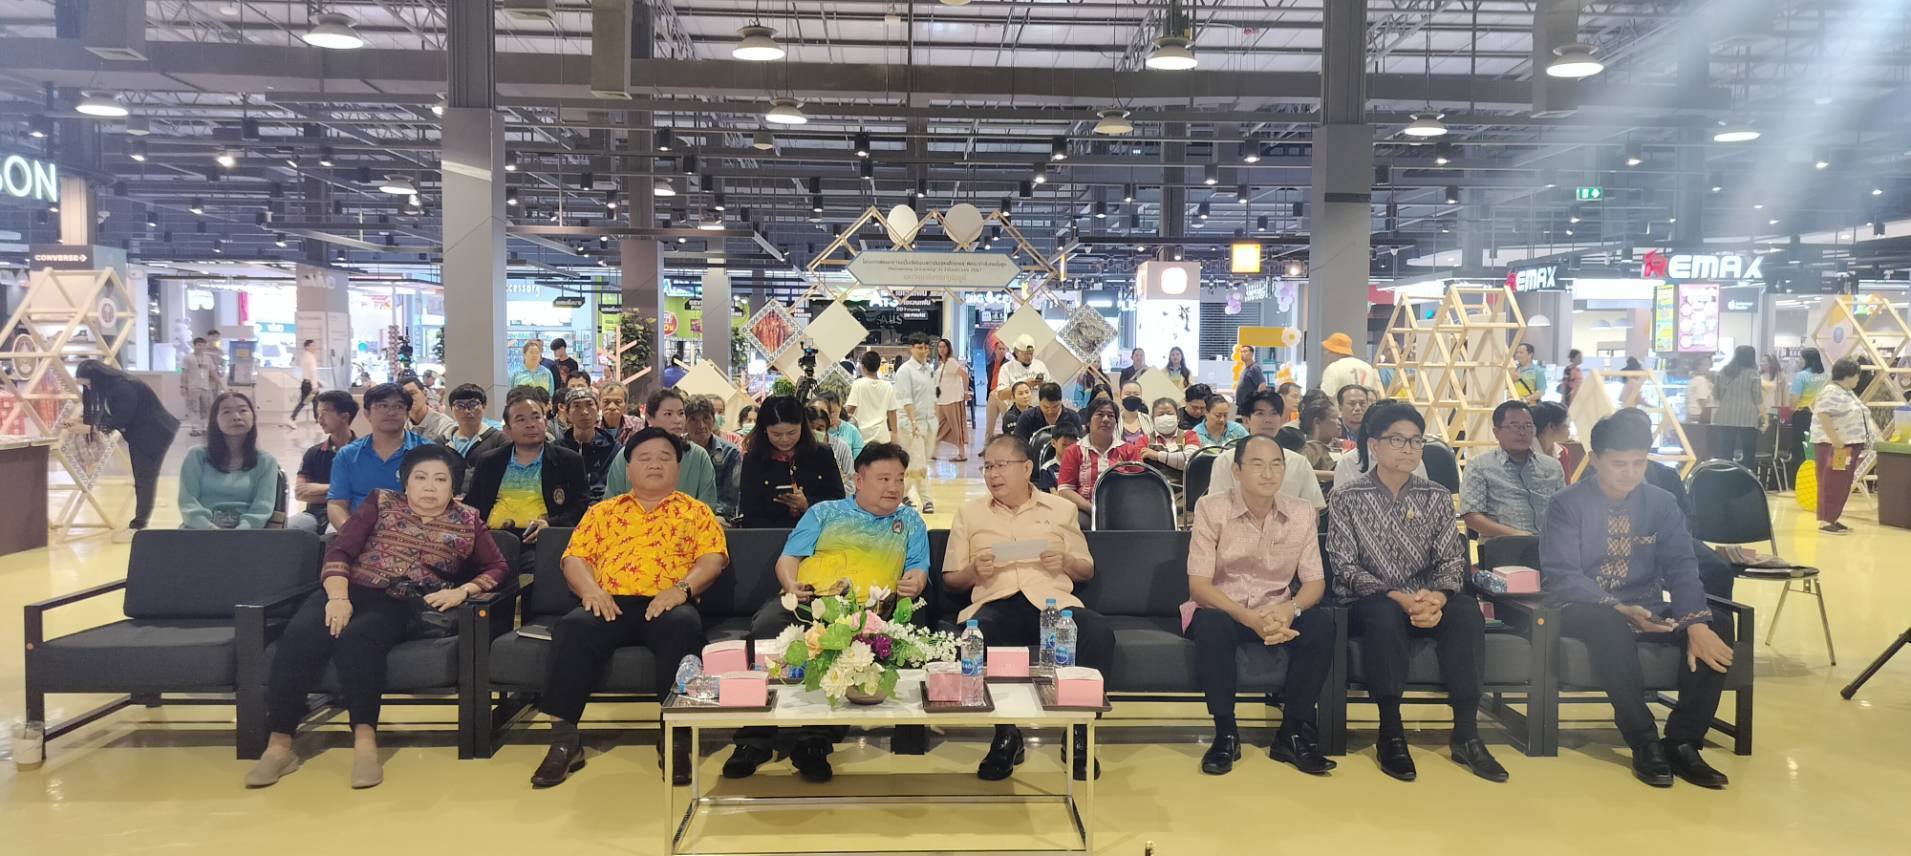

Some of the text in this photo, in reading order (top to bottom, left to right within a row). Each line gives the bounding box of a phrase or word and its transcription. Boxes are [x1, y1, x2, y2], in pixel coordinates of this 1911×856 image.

[0, 155, 57, 202] ON
[34, 254, 79, 262] CONVERSE
[1644, 249, 1764, 280] REMAX
